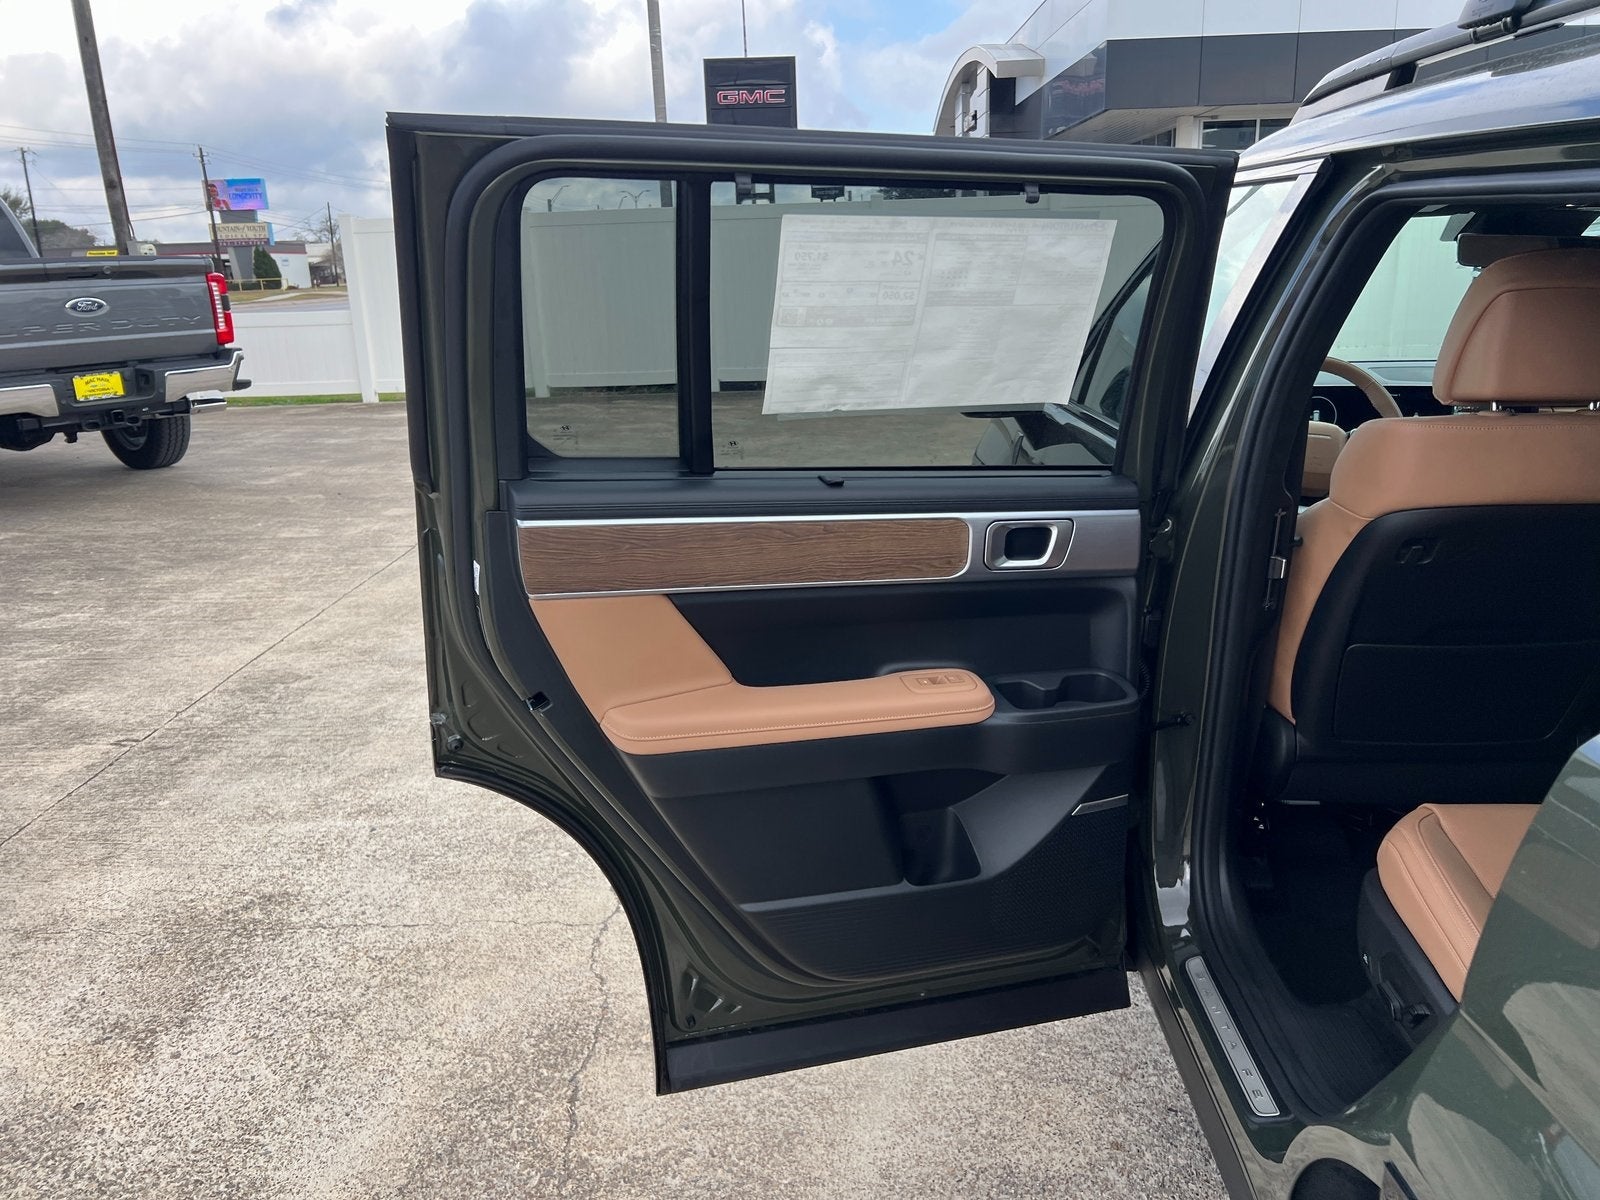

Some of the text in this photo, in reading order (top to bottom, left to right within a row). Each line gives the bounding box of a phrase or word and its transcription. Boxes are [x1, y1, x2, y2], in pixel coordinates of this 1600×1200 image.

[717, 89, 785, 105] GMC
[76, 301, 98, 311] Ford
[111, 315, 201, 330] DUTY
[1241, 1068, 1264, 1099] FE
